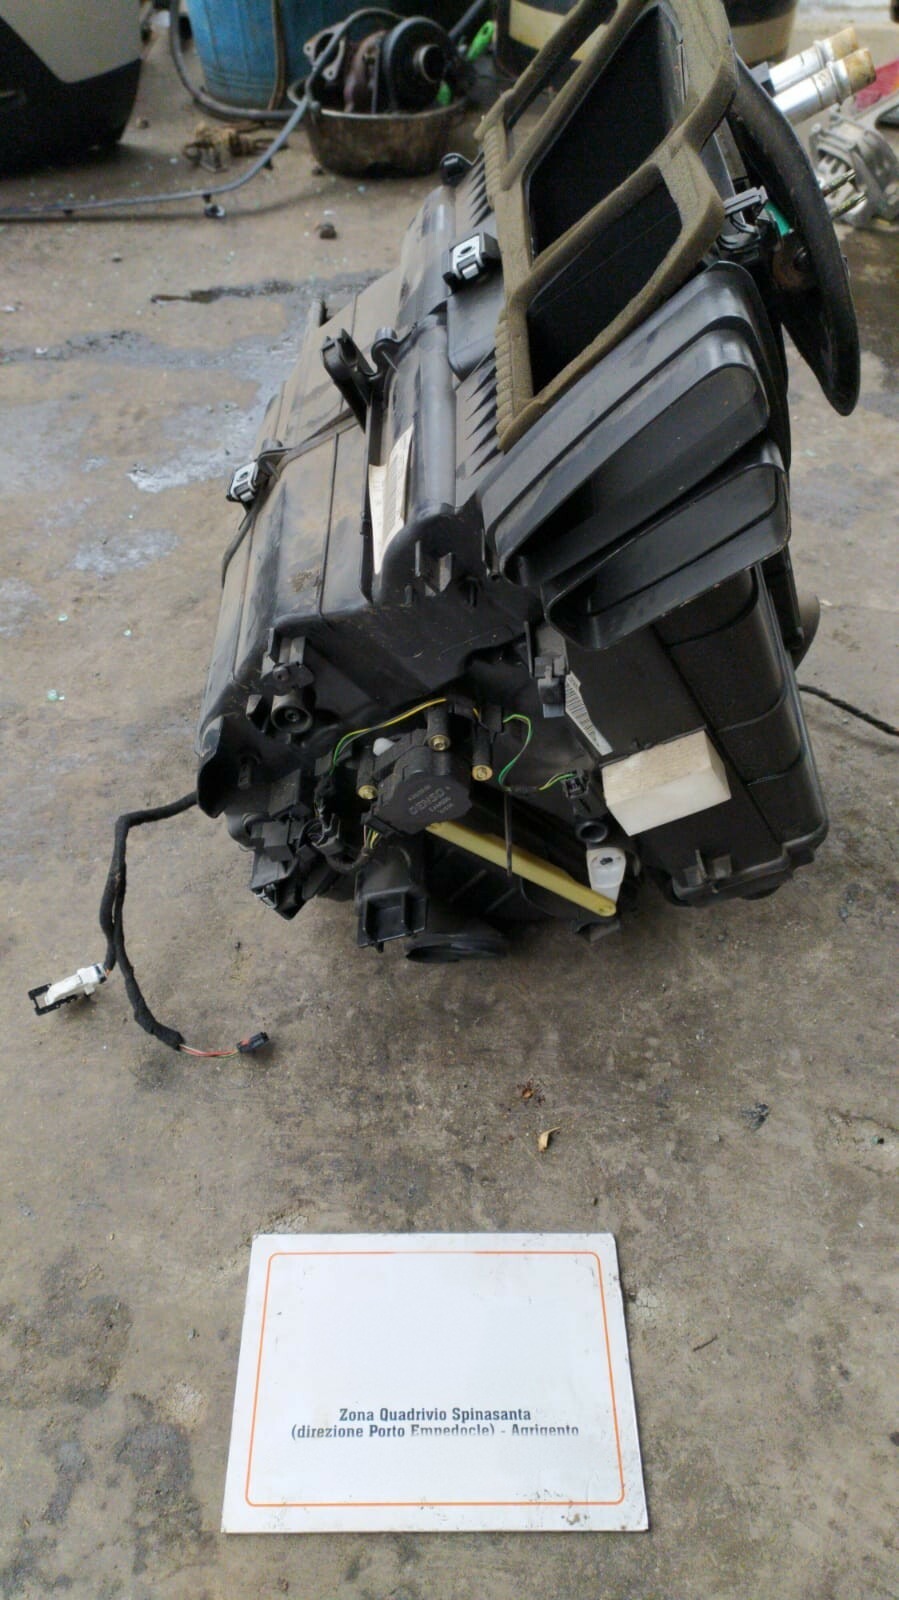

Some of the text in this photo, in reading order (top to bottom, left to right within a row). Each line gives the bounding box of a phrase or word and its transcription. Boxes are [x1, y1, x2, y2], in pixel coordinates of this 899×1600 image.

[339, 1407, 531, 1423] Zona Quadrivio Spinasanta
[291, 1424, 363, 1440] (direzione
[369, 1424, 405, 1438] Porto
